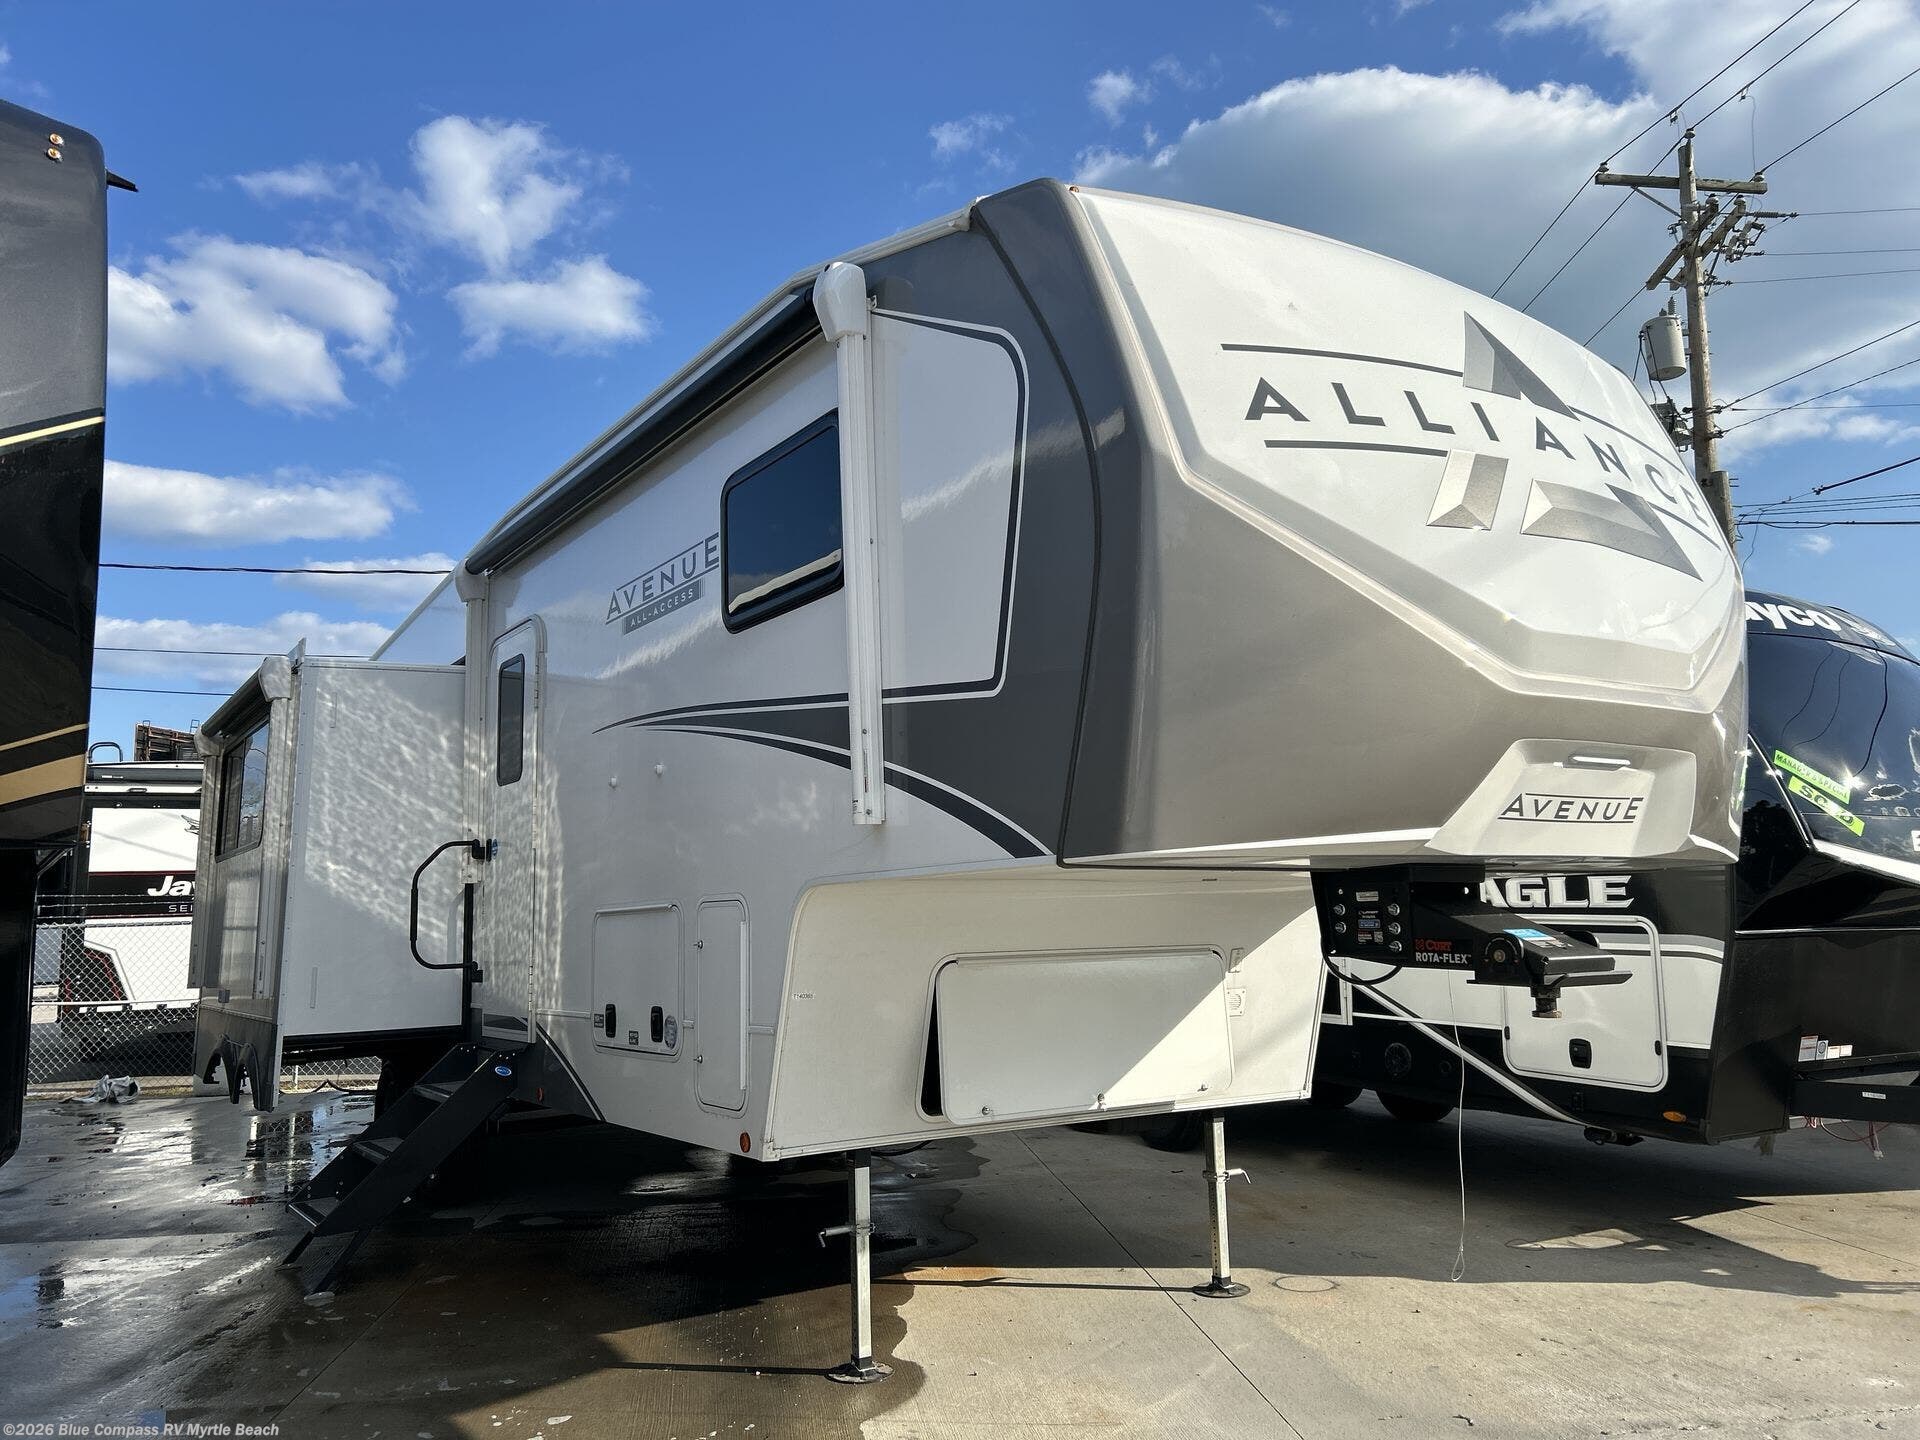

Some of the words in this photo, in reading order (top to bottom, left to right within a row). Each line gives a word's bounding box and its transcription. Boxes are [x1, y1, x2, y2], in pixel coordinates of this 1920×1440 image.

[1244, 376, 1709, 527] ALLIANCE
[606, 532, 720, 620] AVENUE
[629, 588, 695, 628] ALL-ACCESS
[1499, 793, 1645, 821] AVENUE
[1799, 784, 1855, 827] SOD
[147, 875, 196, 897] Ja
